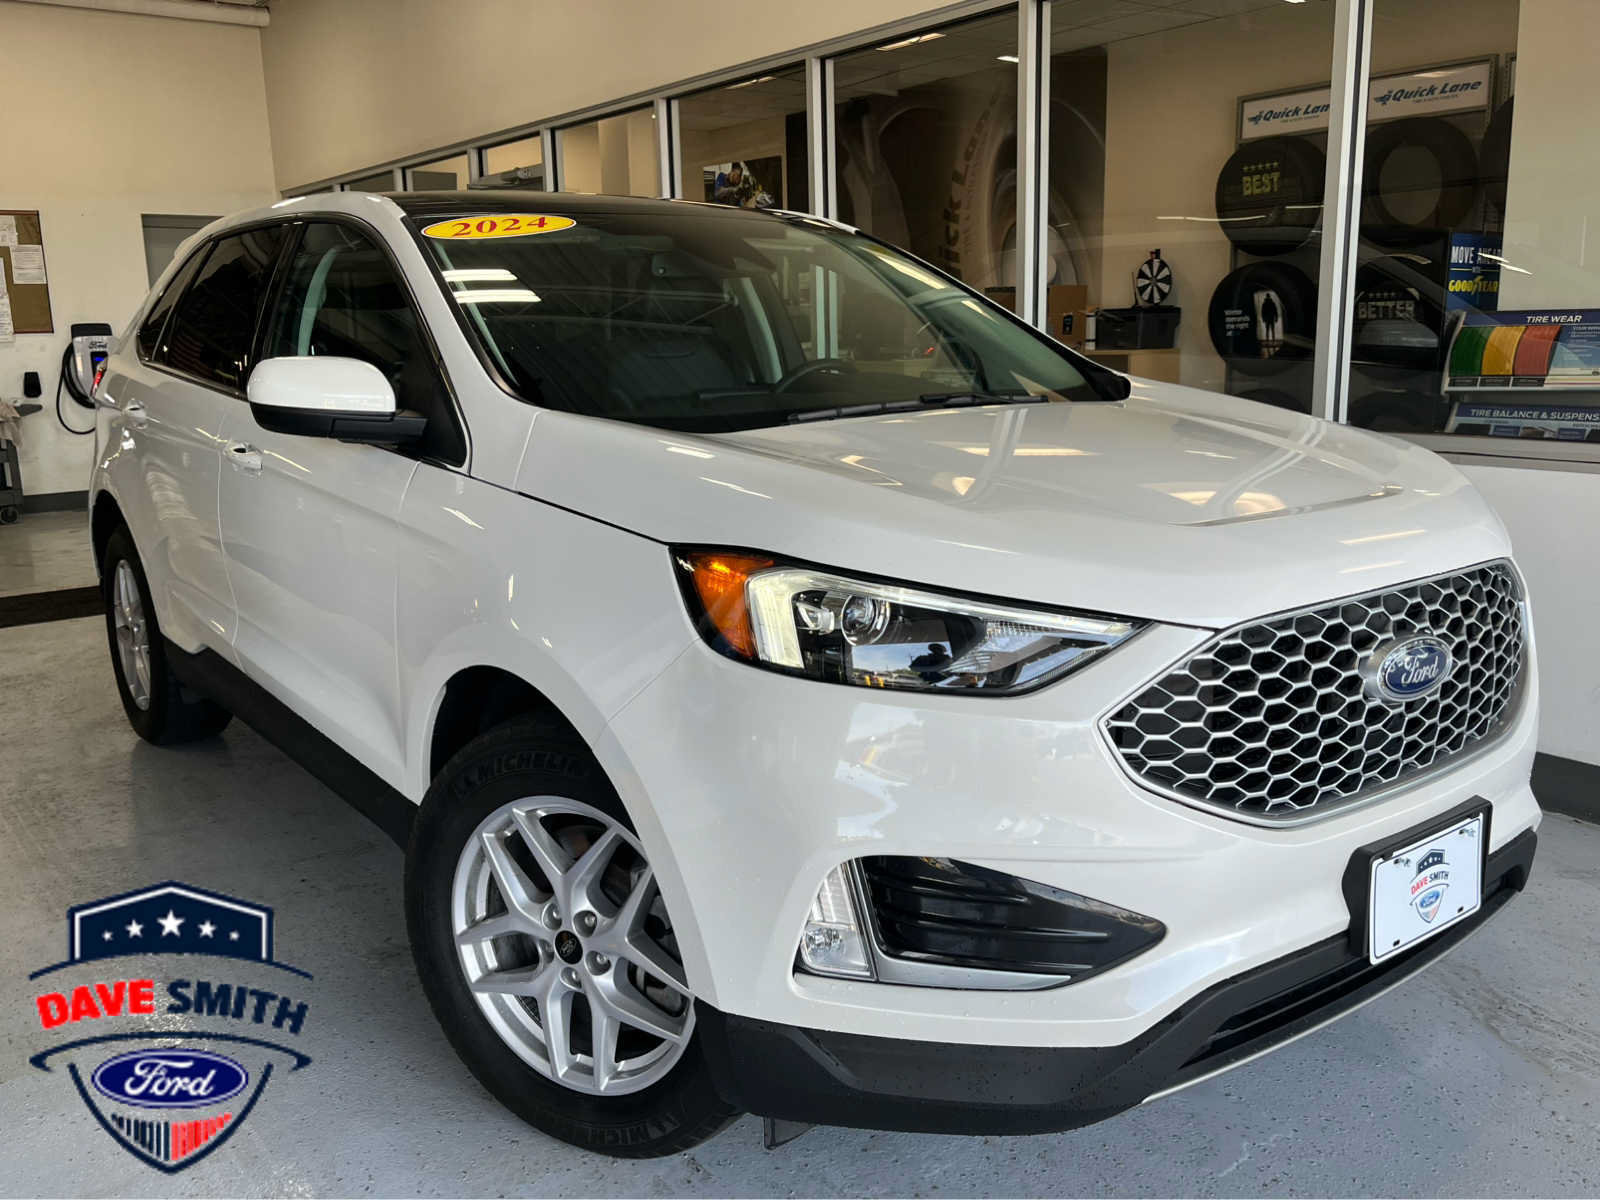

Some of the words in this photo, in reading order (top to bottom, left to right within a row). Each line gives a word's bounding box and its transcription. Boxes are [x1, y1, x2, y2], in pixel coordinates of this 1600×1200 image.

[1392, 85, 1437, 101] Quick
[1440, 81, 1482, 94] Lane
[1263, 106, 1301, 121] Quick
[1303, 104, 1330, 115] Lan
[1242, 172, 1280, 196] BEST
[451, 216, 548, 237] 2024
[1450, 246, 1475, 264] MOVE
[1358, 302, 1415, 320] BETTER
[1526, 315, 1549, 324] TIRE
[1551, 314, 1583, 323] WEAR
[1470, 408, 1492, 417] TIRE
[1492, 408, 1539, 419] BALANCE
[1539, 411, 1548, 419] &
[1401, 651, 1440, 687] Ford
[1411, 876, 1429, 896] DAVE
[1428, 870, 1449, 883] SMITH
